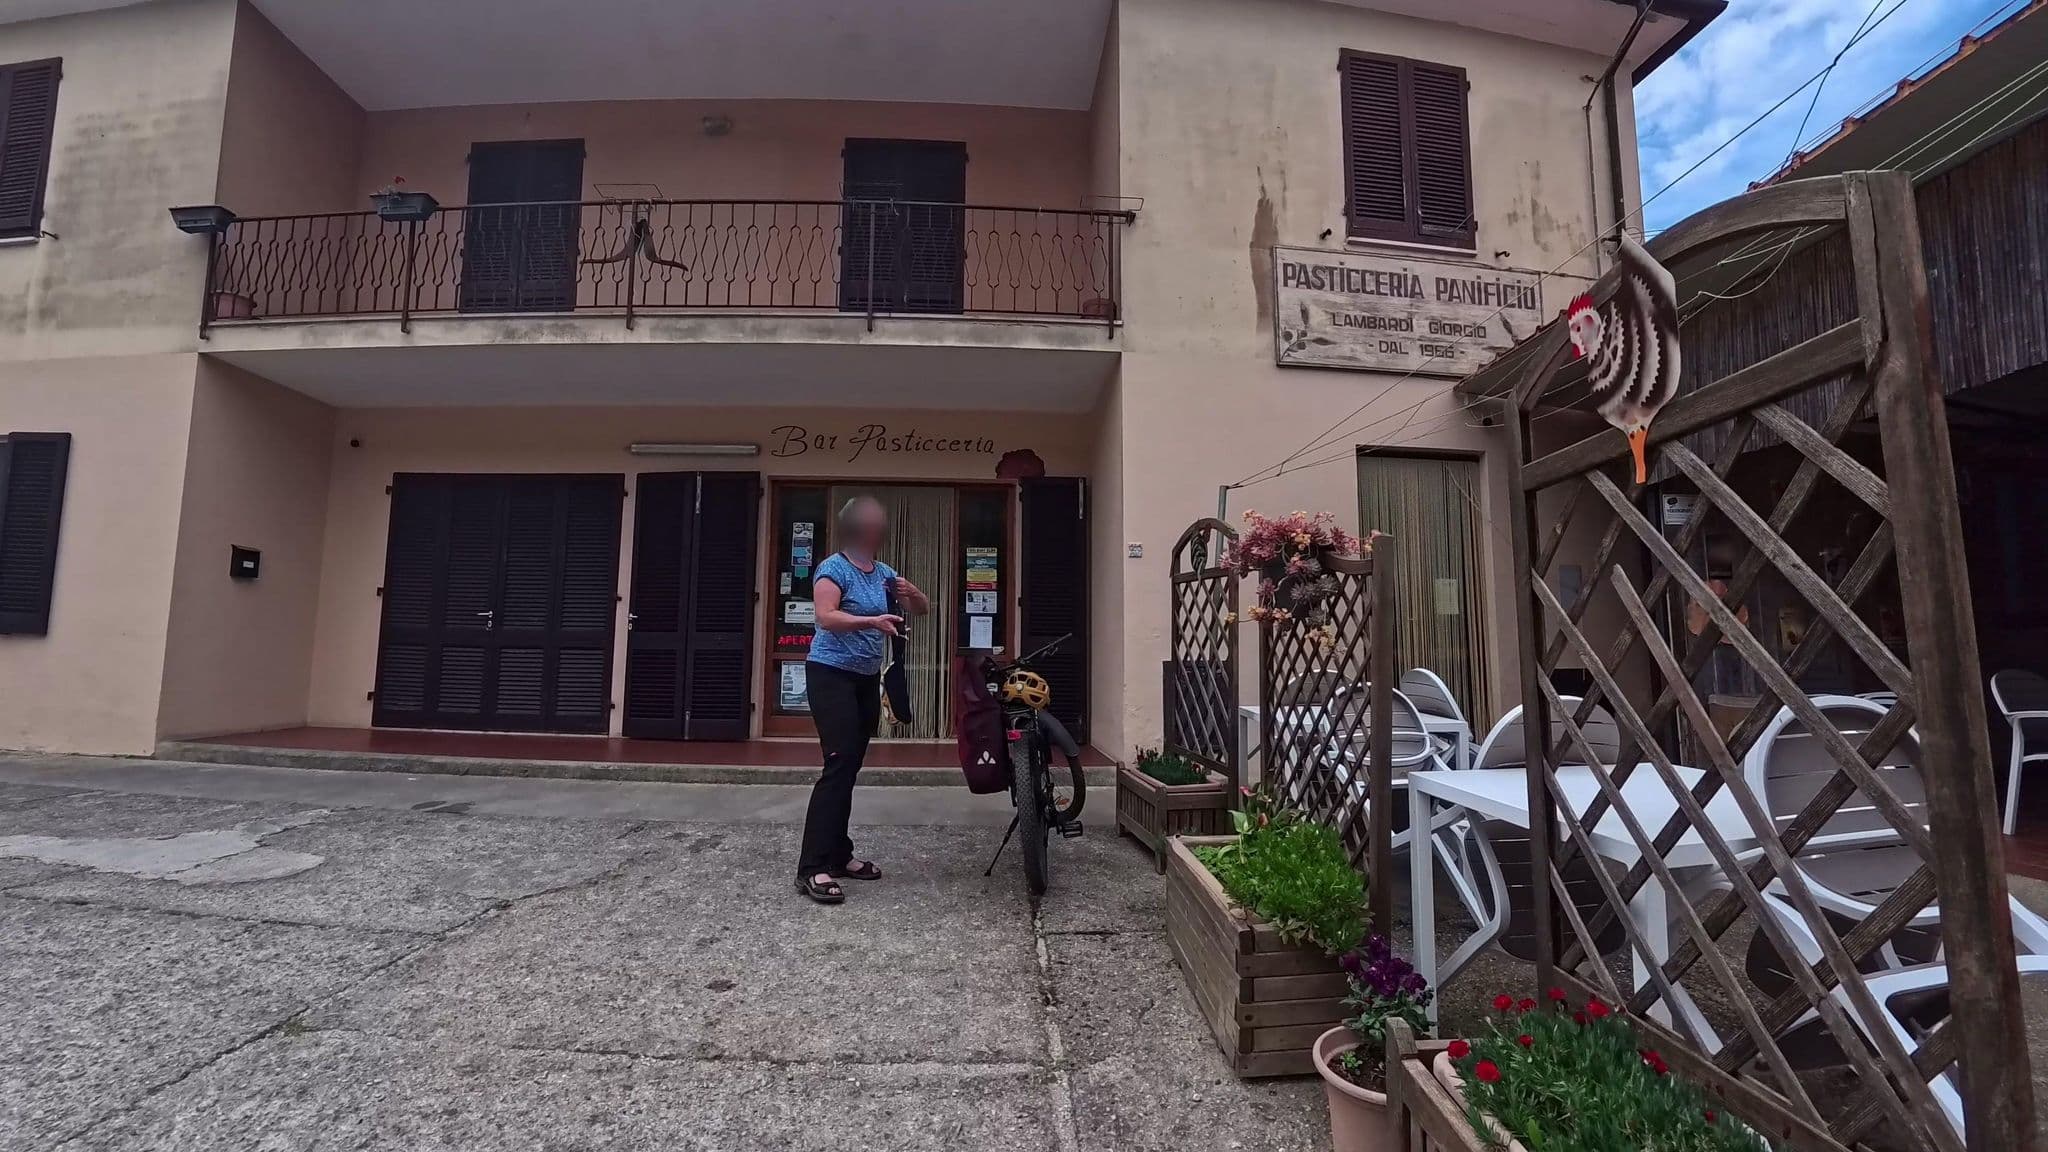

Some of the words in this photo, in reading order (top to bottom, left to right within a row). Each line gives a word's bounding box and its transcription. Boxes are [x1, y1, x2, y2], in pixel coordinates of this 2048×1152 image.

[1429, 320, 1487, 339] GIORGIO
[1379, 340, 1409, 355] DAL
[771, 425, 838, 457] Bar
[848, 424, 995, 463] Pasticceria
[778, 635, 812, 646] APERT
